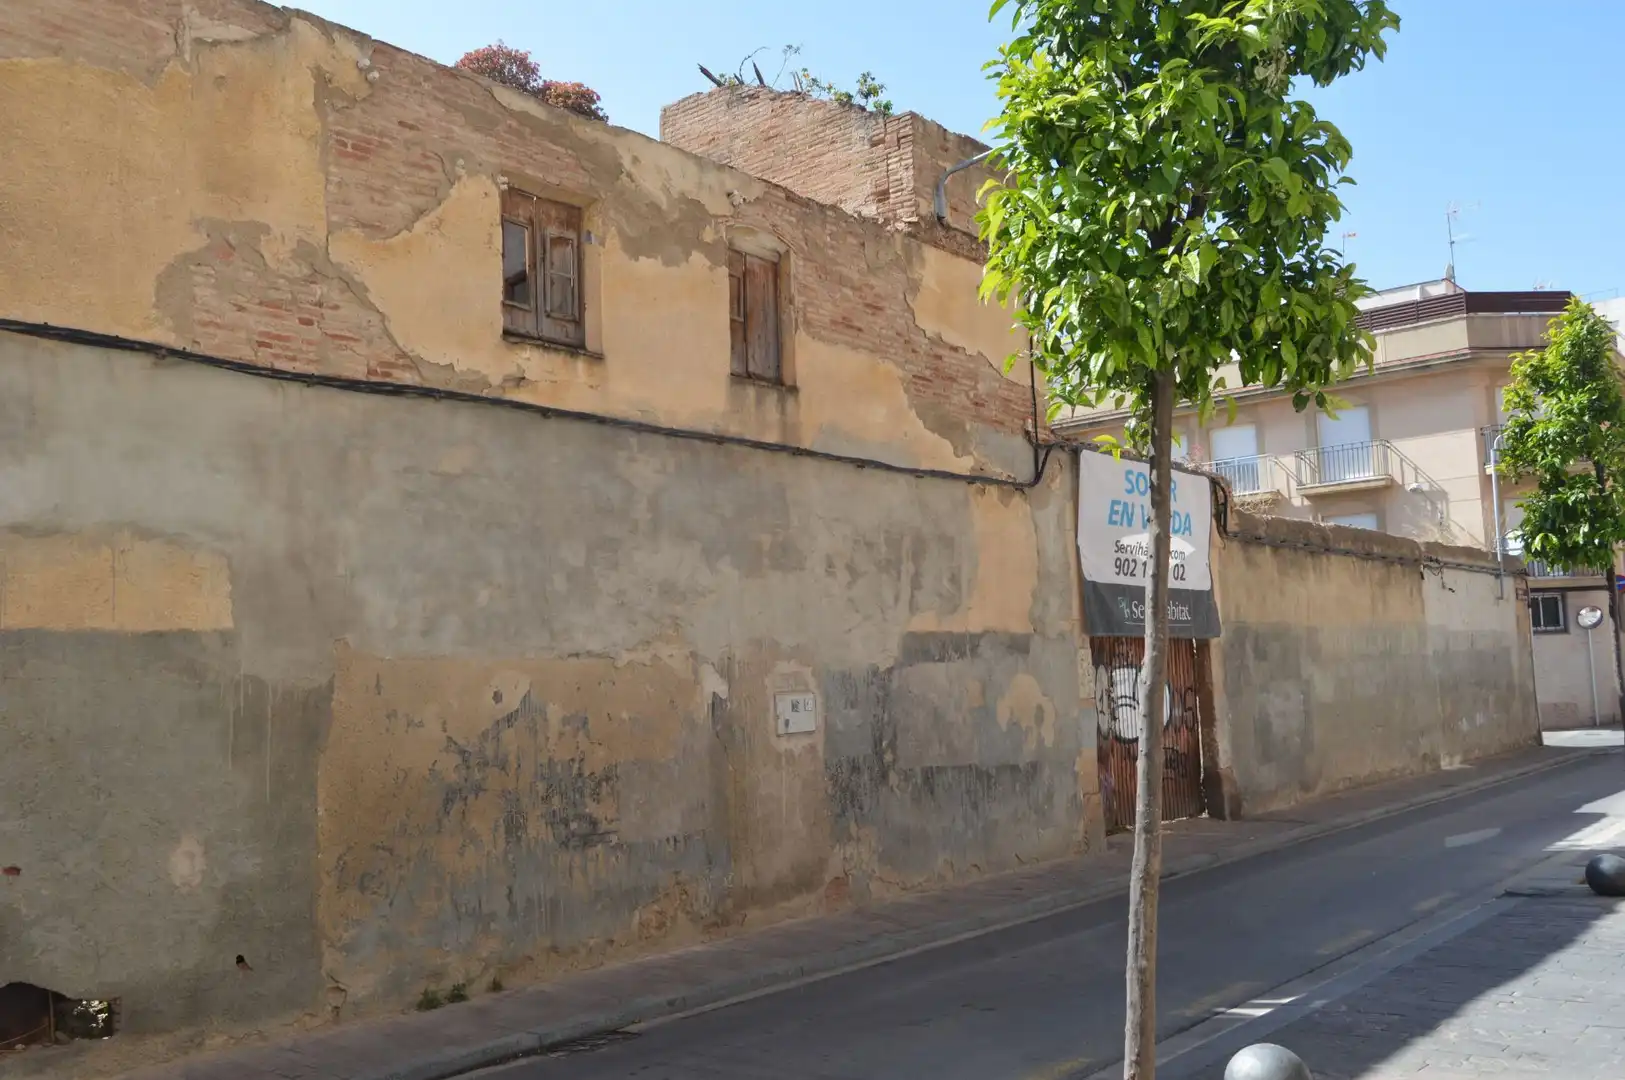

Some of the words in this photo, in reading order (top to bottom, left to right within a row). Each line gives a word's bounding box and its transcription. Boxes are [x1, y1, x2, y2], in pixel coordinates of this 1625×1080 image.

[1124, 469, 1177, 503] SOR
[1107, 499, 1135, 528] EN
[1140, 503, 1192, 537] VDA
[1114, 556, 1137, 578] 902
